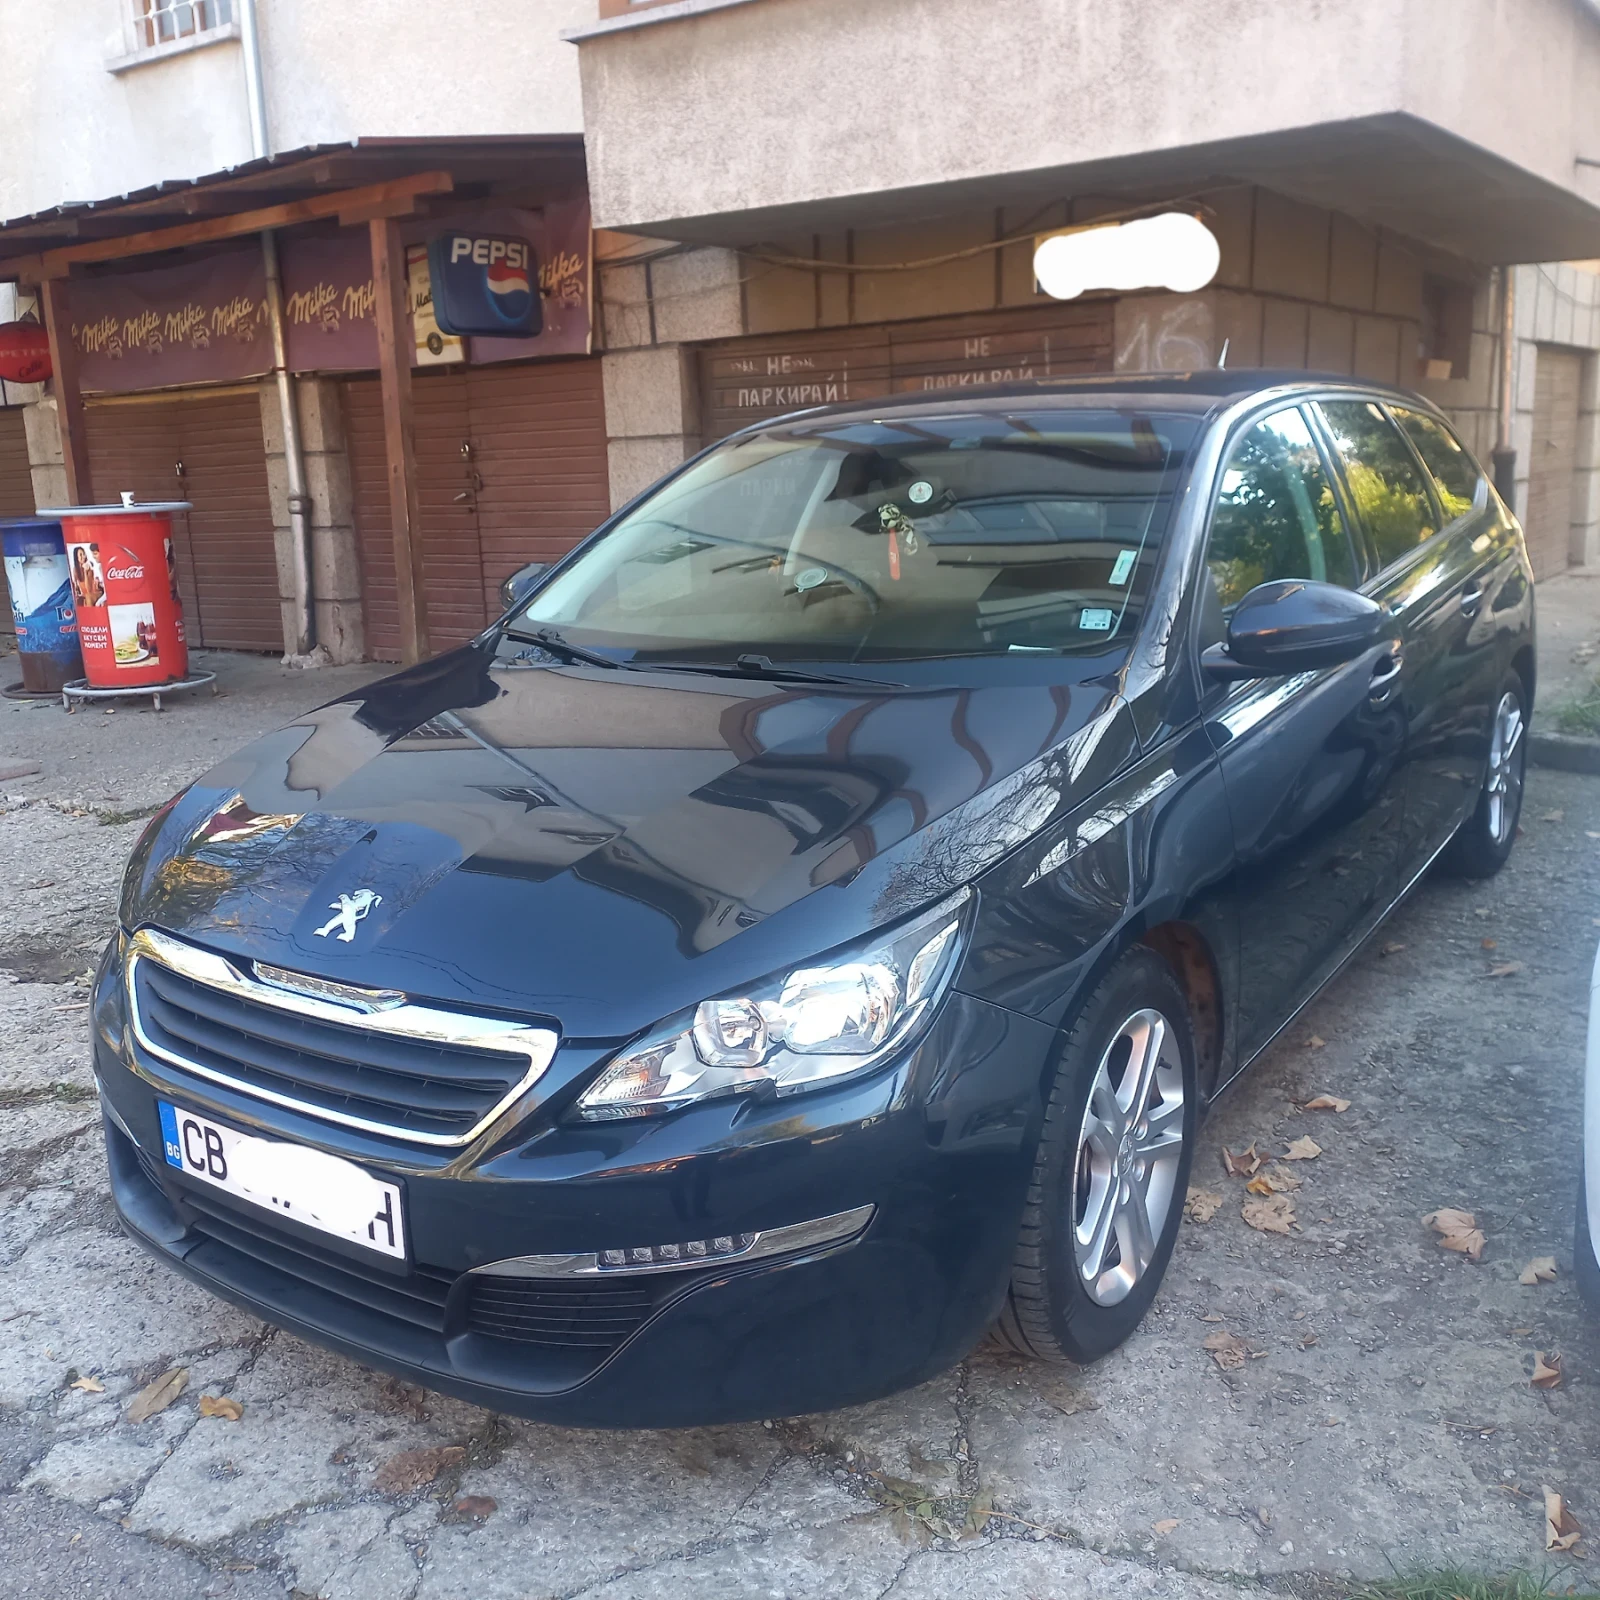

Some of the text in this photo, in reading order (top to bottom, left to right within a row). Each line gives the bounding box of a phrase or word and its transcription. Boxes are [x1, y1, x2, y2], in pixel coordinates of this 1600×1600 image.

[451, 237, 528, 270] PEPSI
[82, 315, 120, 353] Milka
[123, 309, 161, 348] Milka
[165, 302, 206, 343] Milka
[211, 296, 254, 337] Milka
[286, 282, 338, 325] Milka
[342, 279, 375, 320] Mil
[964, 336, 991, 359] НЕ
[1114, 300, 1213, 373] 16
[767, 355, 792, 376] НЕ
[166, 1141, 181, 1160] BG
[182, 1119, 227, 1181] CB
